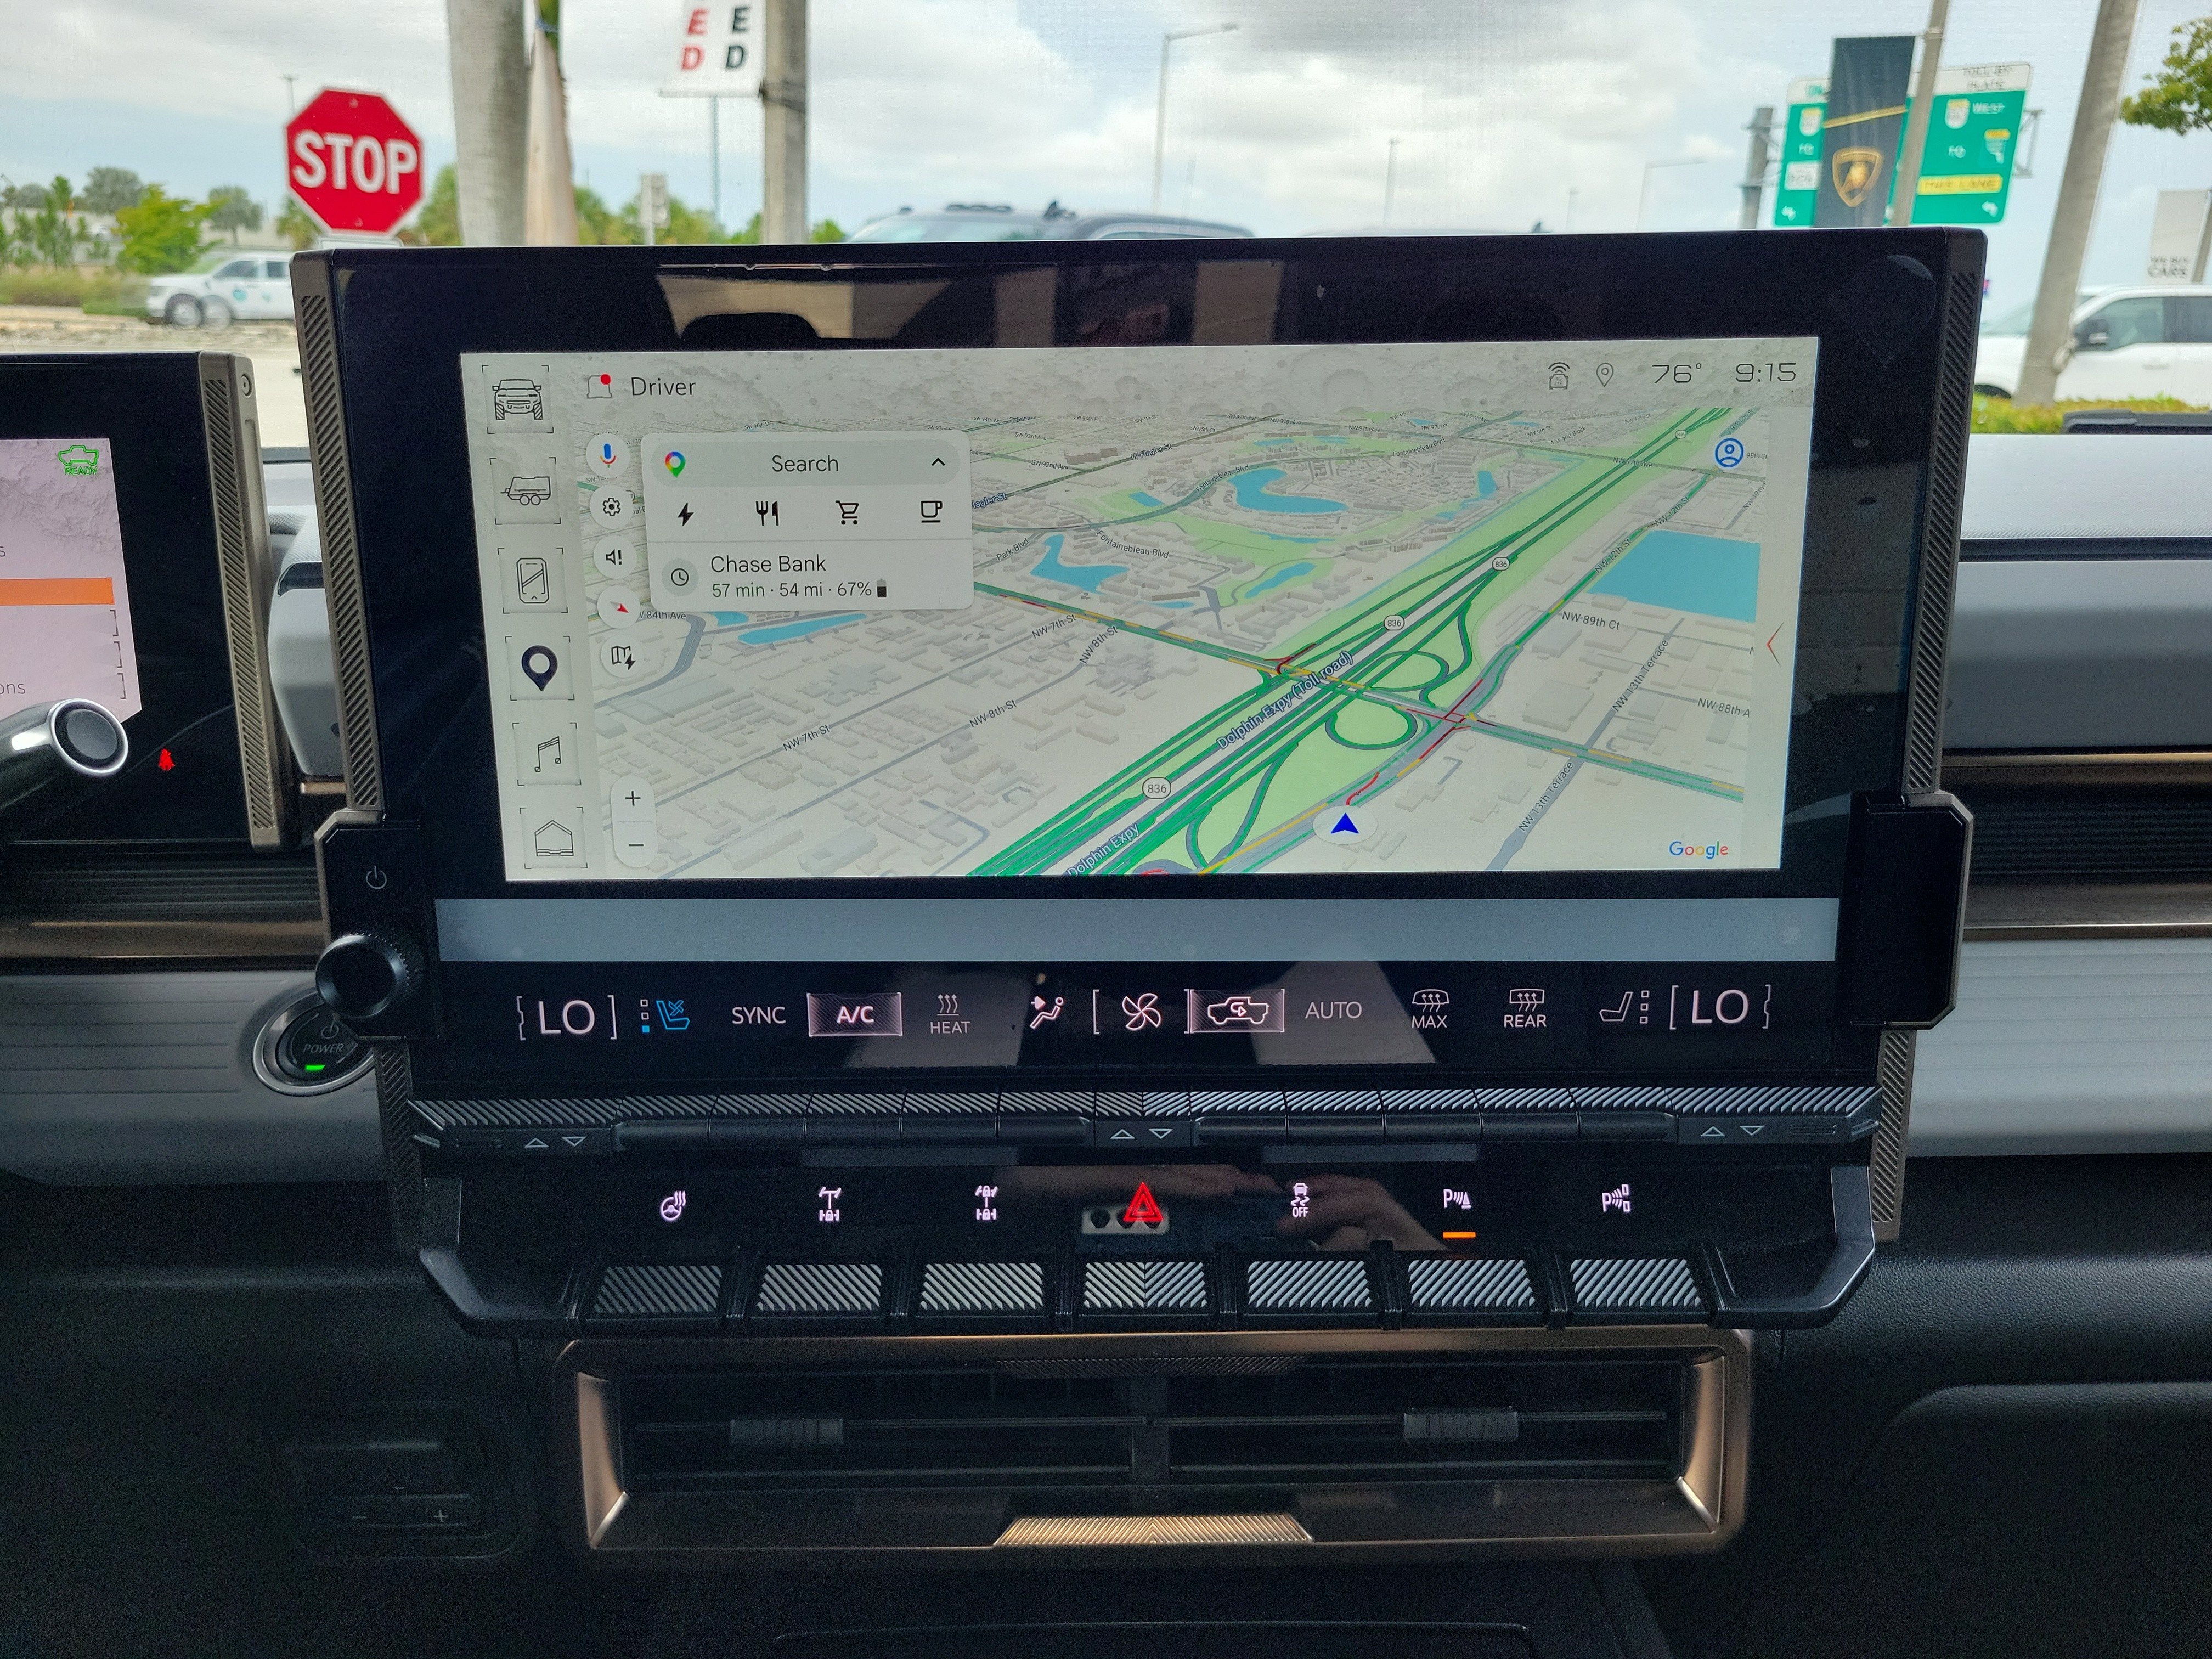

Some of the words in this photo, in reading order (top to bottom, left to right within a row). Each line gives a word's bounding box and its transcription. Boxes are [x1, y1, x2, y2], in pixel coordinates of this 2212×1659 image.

[294, 130, 418, 194] STOP
[1652, 363, 1702, 383] 76°
[1735, 363, 1796, 383] 9:15
[631, 376, 697, 397] Driver
[1432, 437, 1446, 448] Blvd
[65, 466, 98, 476] READY
[772, 455, 839, 472] Search
[1042, 461, 1057, 470] 92nd
[1196, 467, 1234, 492] Fontainebleau
[1234, 464, 1249, 475] Blvd
[971, 494, 996, 510] lagler
[996, 493, 1008, 503] St
[1655, 513, 1670, 526] NW
[1669, 501, 1684, 519] 12th
[1679, 496, 1690, 509] St
[996, 546, 1013, 562] Park
[1011, 537, 1029, 554] Blvd
[1096, 529, 1150, 555] Fontainebleau
[1152, 549, 1170, 559] Blvd
[711, 555, 772, 573] Chase
[778, 554, 827, 573] Bank
[1495, 559, 1508, 568] 836
[1595, 557, 1609, 573] NW
[1607, 544, 1624, 562] 12th
[1621, 538, 1632, 551] St
[712, 583, 731, 597] 57
[736, 582, 765, 597] min
[779, 582, 799, 597] 54
[804, 582, 823, 597] mi
[837, 582, 872, 597] 67%
[646, 611, 668, 620] 84th
[670, 612, 686, 620] Ave
[1387, 618, 1402, 627] 836
[1562, 611, 1582, 623] NW
[1583, 615, 1606, 629] 89th
[1608, 619, 1621, 631] Ct
[1031, 625, 1049, 639] NW
[1048, 618, 1065, 633] 7th
[1065, 613, 1077, 624] St
[1080, 646, 1097, 664] NW
[1092, 633, 1109, 648] 8th
[1107, 626, 1119, 639] St
[1612, 693, 1629, 712] NW
[1625, 671, 1645, 696] 13th
[1640, 639, 1669, 674] Terrace
[1216, 712, 1263, 751] Dolphin
[1260, 690, 1293, 720] Expy
[1292, 671, 1321, 702] (Toll
[1319, 650, 1354, 681] road)
[1698, 698, 1717, 711] NW
[1718, 701, 1741, 716] 88th
[969, 712, 988, 729] NW
[988, 705, 1006, 723] 8th
[1005, 699, 1018, 712] St
[782, 736, 801, 752] NW
[800, 730, 818, 744] 7th
[818, 724, 830, 737] St
[1147, 783, 1167, 794] 836
[1518, 814, 1534, 832] NW
[1531, 792, 1551, 816] 13th
[1545, 760, 1574, 795] Terrace
[1066, 840, 1113, 876] Dolphin
[1109, 822, 1141, 851] Expy
[1669, 840, 1729, 859] Google
[732, 1006, 786, 1025] SYNC
[836, 1006, 875, 1024] A/C
[1305, 1001, 1363, 1019] AUTO
[1691, 989, 1750, 1025] LO
[539, 1000, 596, 1035] LO
[1412, 1015, 1448, 1029] MAX
[1504, 1014, 1547, 1028] REAR
[930, 1021, 971, 1035] HEAT
[303, 1042, 345, 1054] POWER
[1291, 1206, 1309, 1218] OFF
